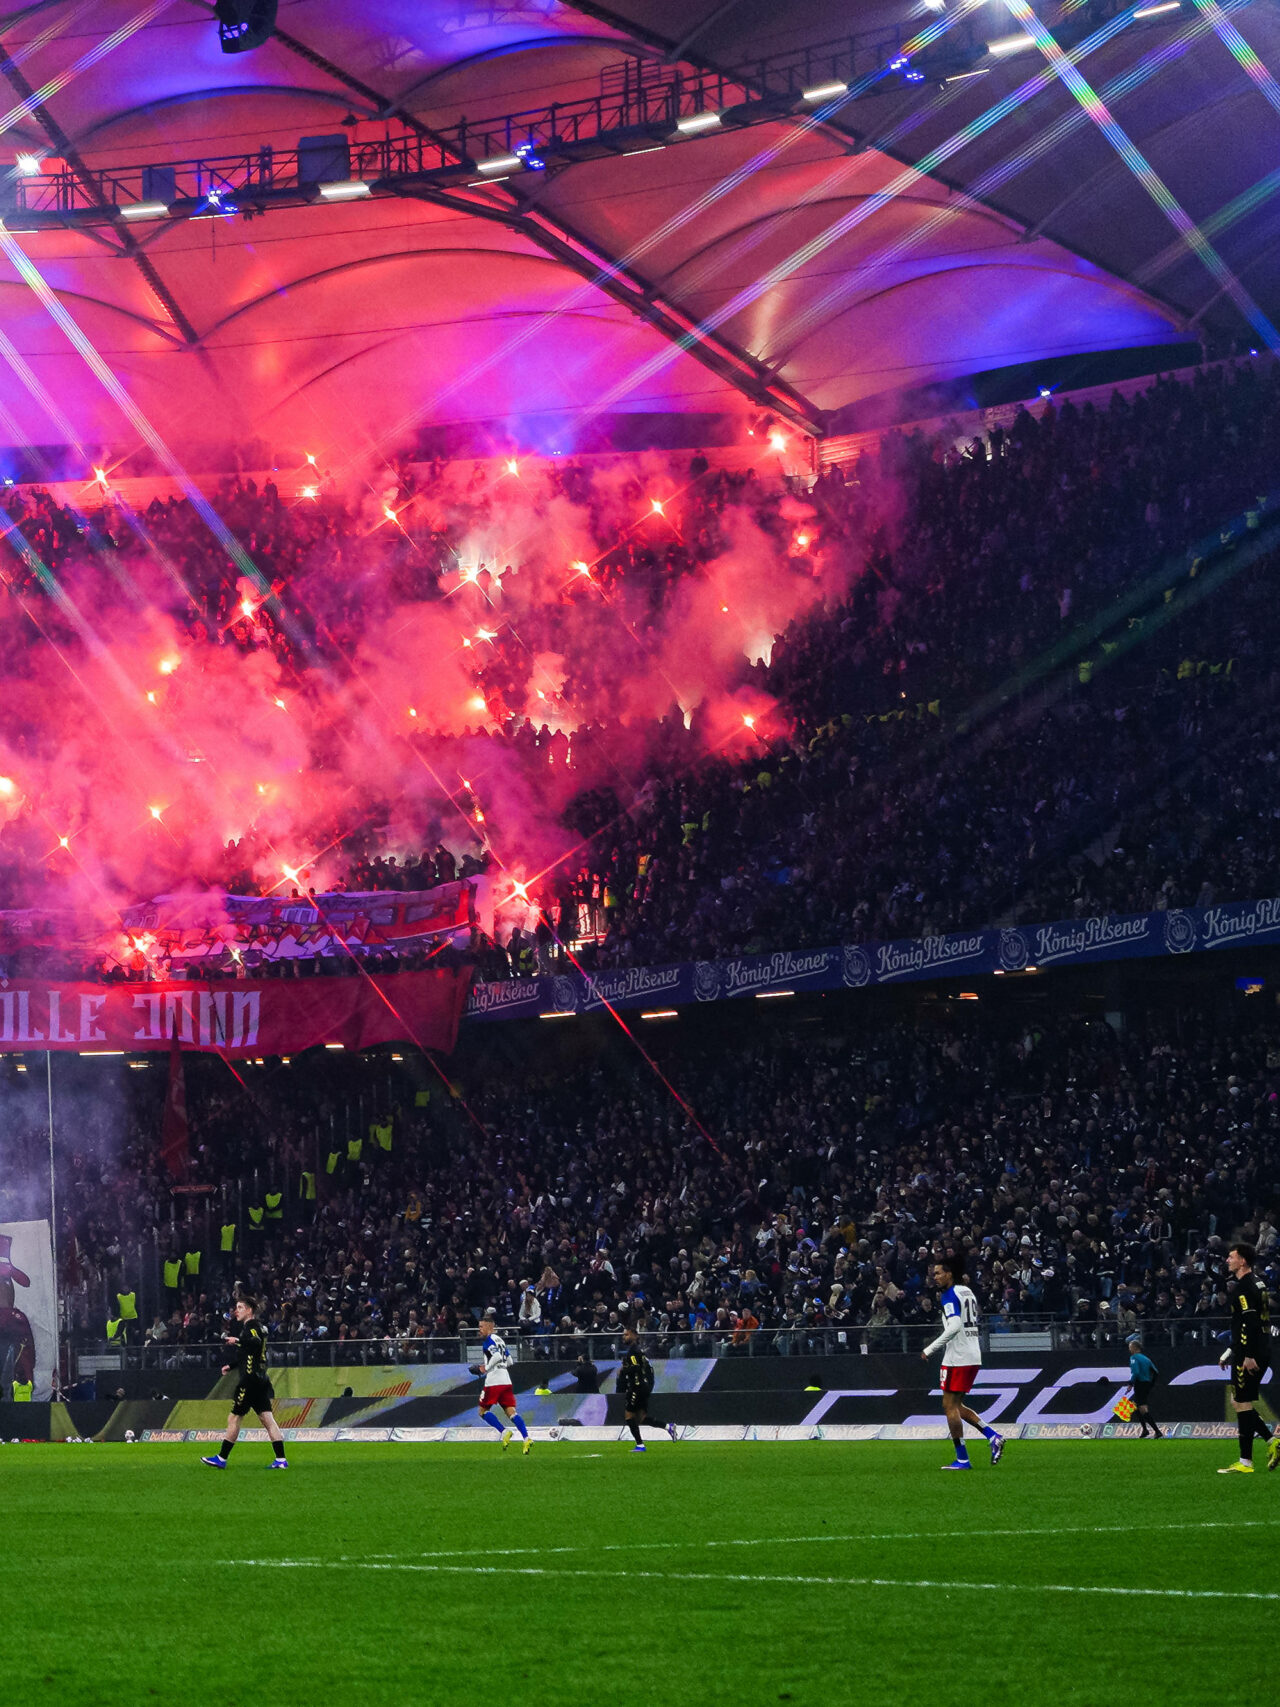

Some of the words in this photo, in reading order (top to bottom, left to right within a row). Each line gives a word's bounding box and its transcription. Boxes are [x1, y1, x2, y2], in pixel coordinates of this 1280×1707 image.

[876, 945, 923, 970] König
[923, 935, 983, 961] Pilsener
[1035, 926, 1085, 953] König
[1085, 916, 1148, 945] Pilsener
[725, 960, 770, 985] König
[770, 952, 829, 977] Pilsener
[132, 990, 262, 1048] JONN
